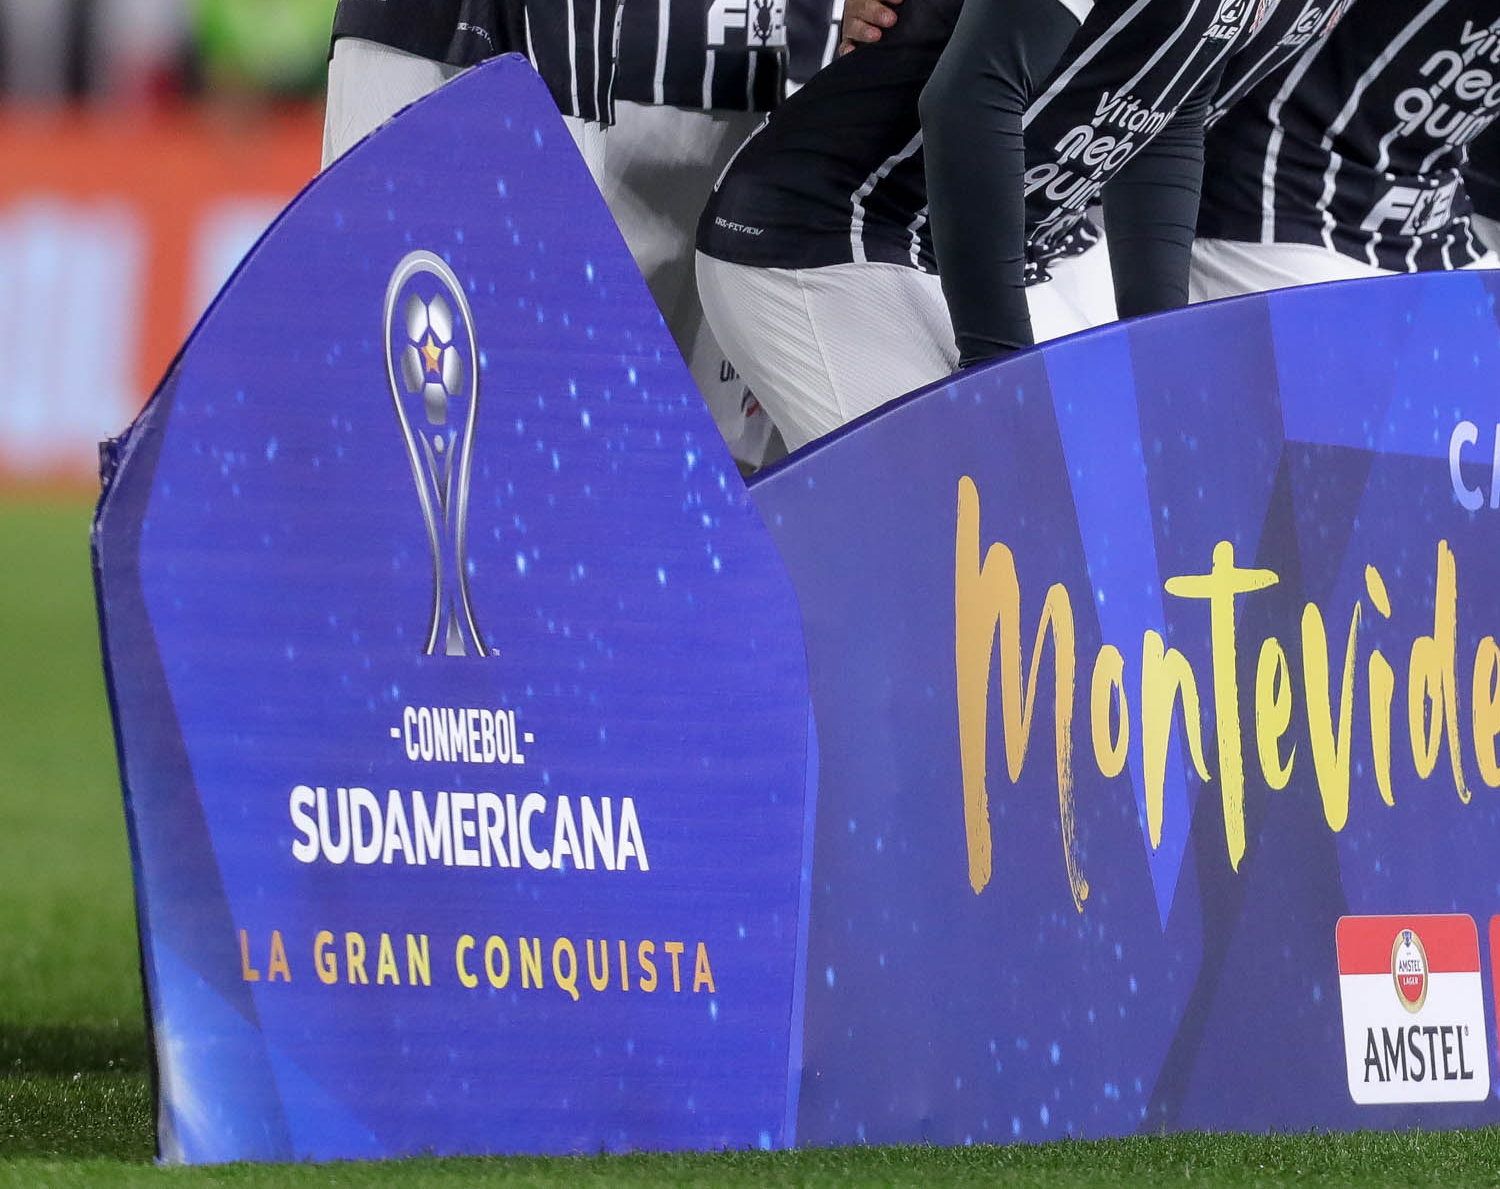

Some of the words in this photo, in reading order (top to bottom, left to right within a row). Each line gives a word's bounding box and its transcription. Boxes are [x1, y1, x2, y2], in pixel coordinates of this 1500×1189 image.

[1201, 24, 1240, 40] ALE
[1054, 124, 1135, 171] neo
[289, 783, 650, 872] SUDAMERICANA
[239, 928, 292, 983] LA
[313, 929, 432, 987] GRAN
[455, 933, 717, 1001] CONQUISTA
[1399, 959, 1422, 973] AMSTEL
[1403, 977, 1419, 986] LAGER
